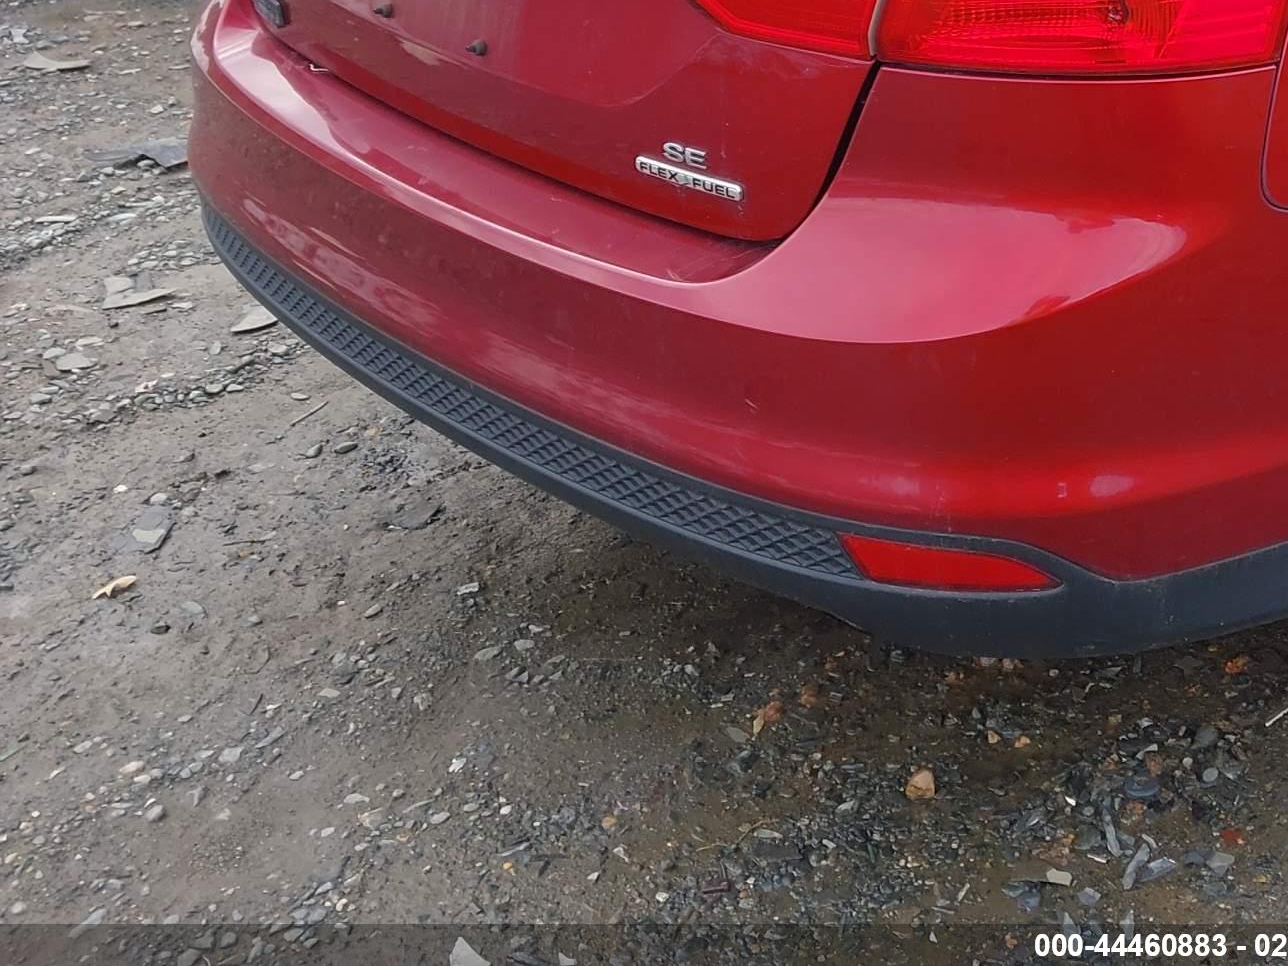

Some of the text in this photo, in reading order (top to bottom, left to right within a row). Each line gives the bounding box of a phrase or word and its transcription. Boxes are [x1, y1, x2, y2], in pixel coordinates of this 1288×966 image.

[662, 141, 708, 170] SE
[639, 161, 738, 199] FLEX FUEL
